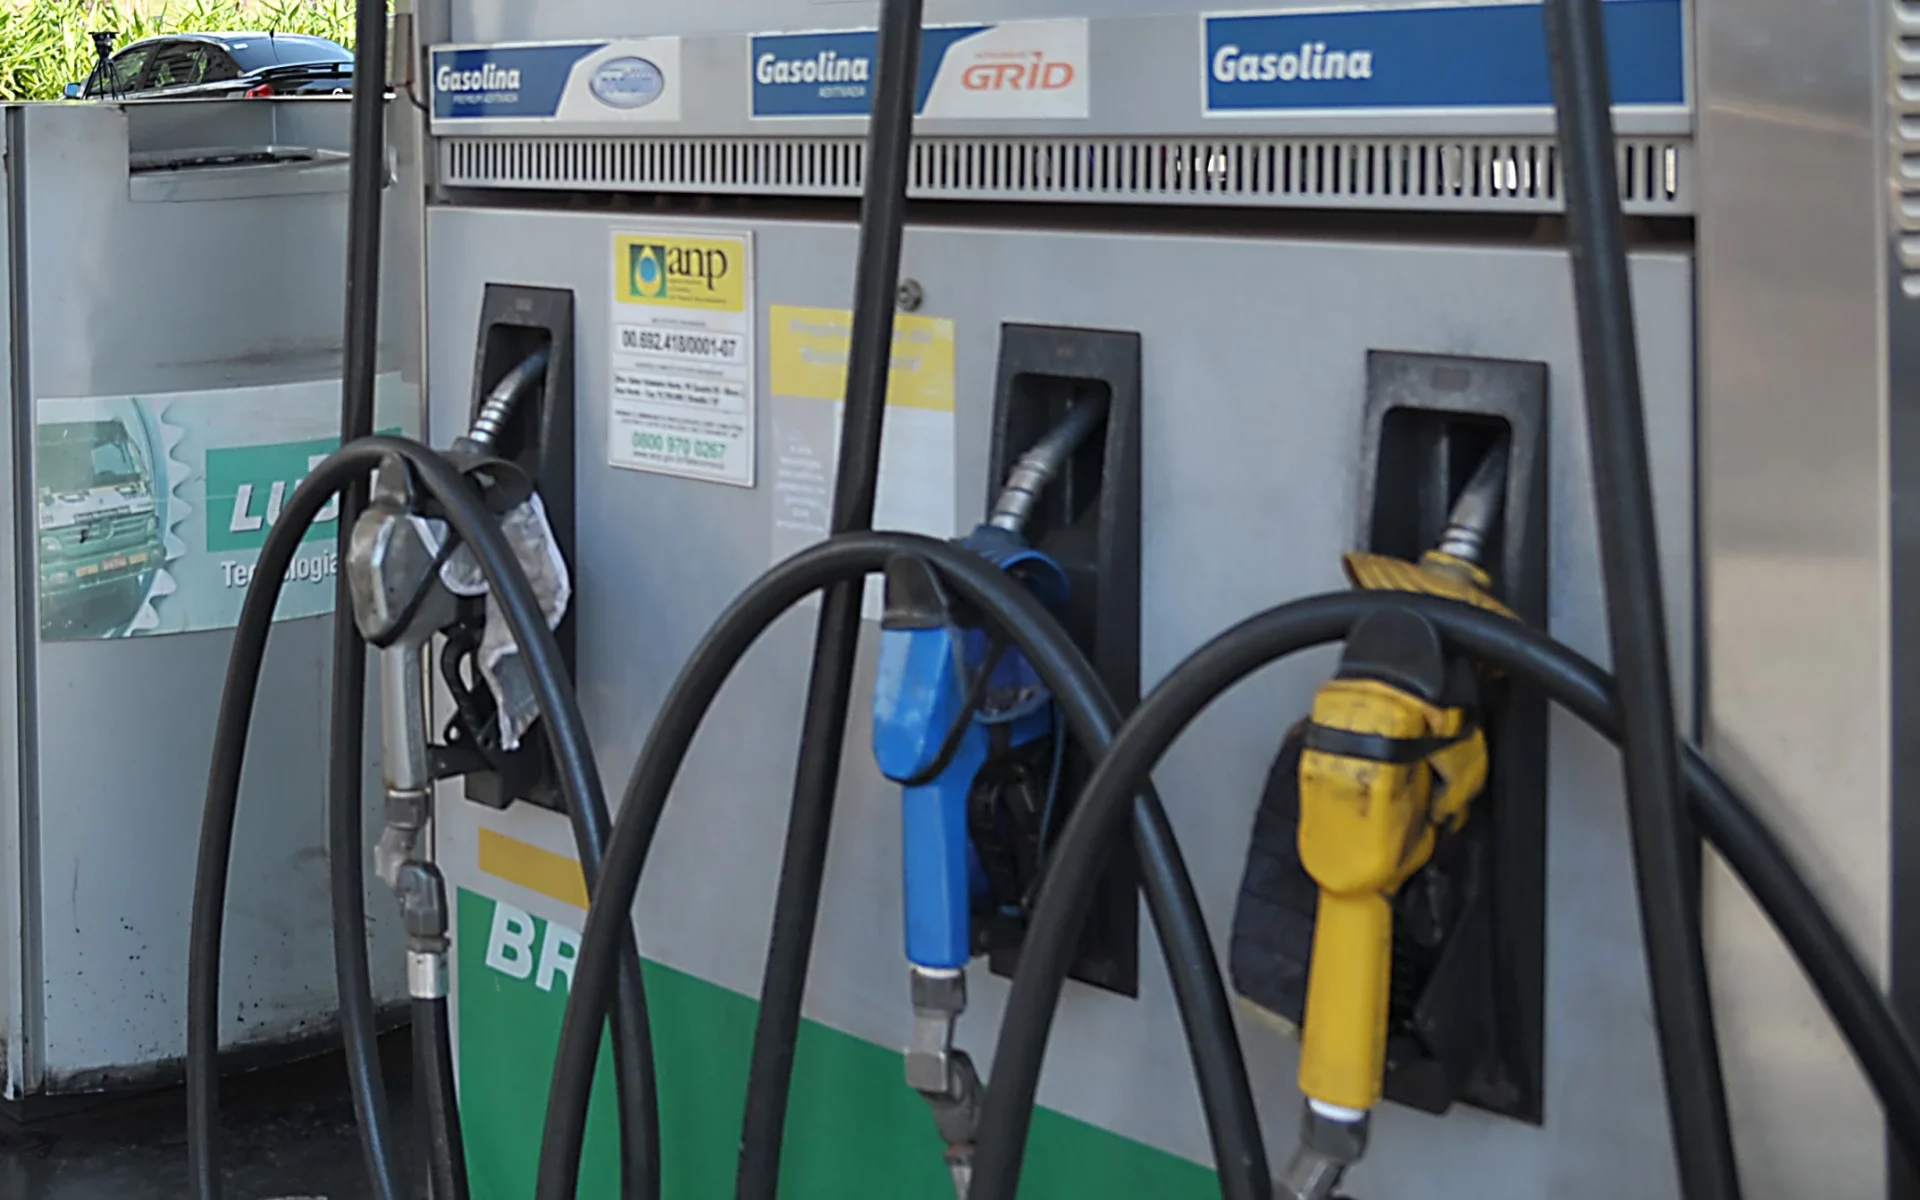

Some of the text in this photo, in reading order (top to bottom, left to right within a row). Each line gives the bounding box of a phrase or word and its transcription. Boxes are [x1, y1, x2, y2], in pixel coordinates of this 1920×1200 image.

[436, 63, 521, 92] Gasolina
[756, 51, 870, 84] Gasolina
[1213, 42, 1373, 82] Gasolina
[668, 246, 728, 291] anp
[221, 549, 338, 587] Teclogia
